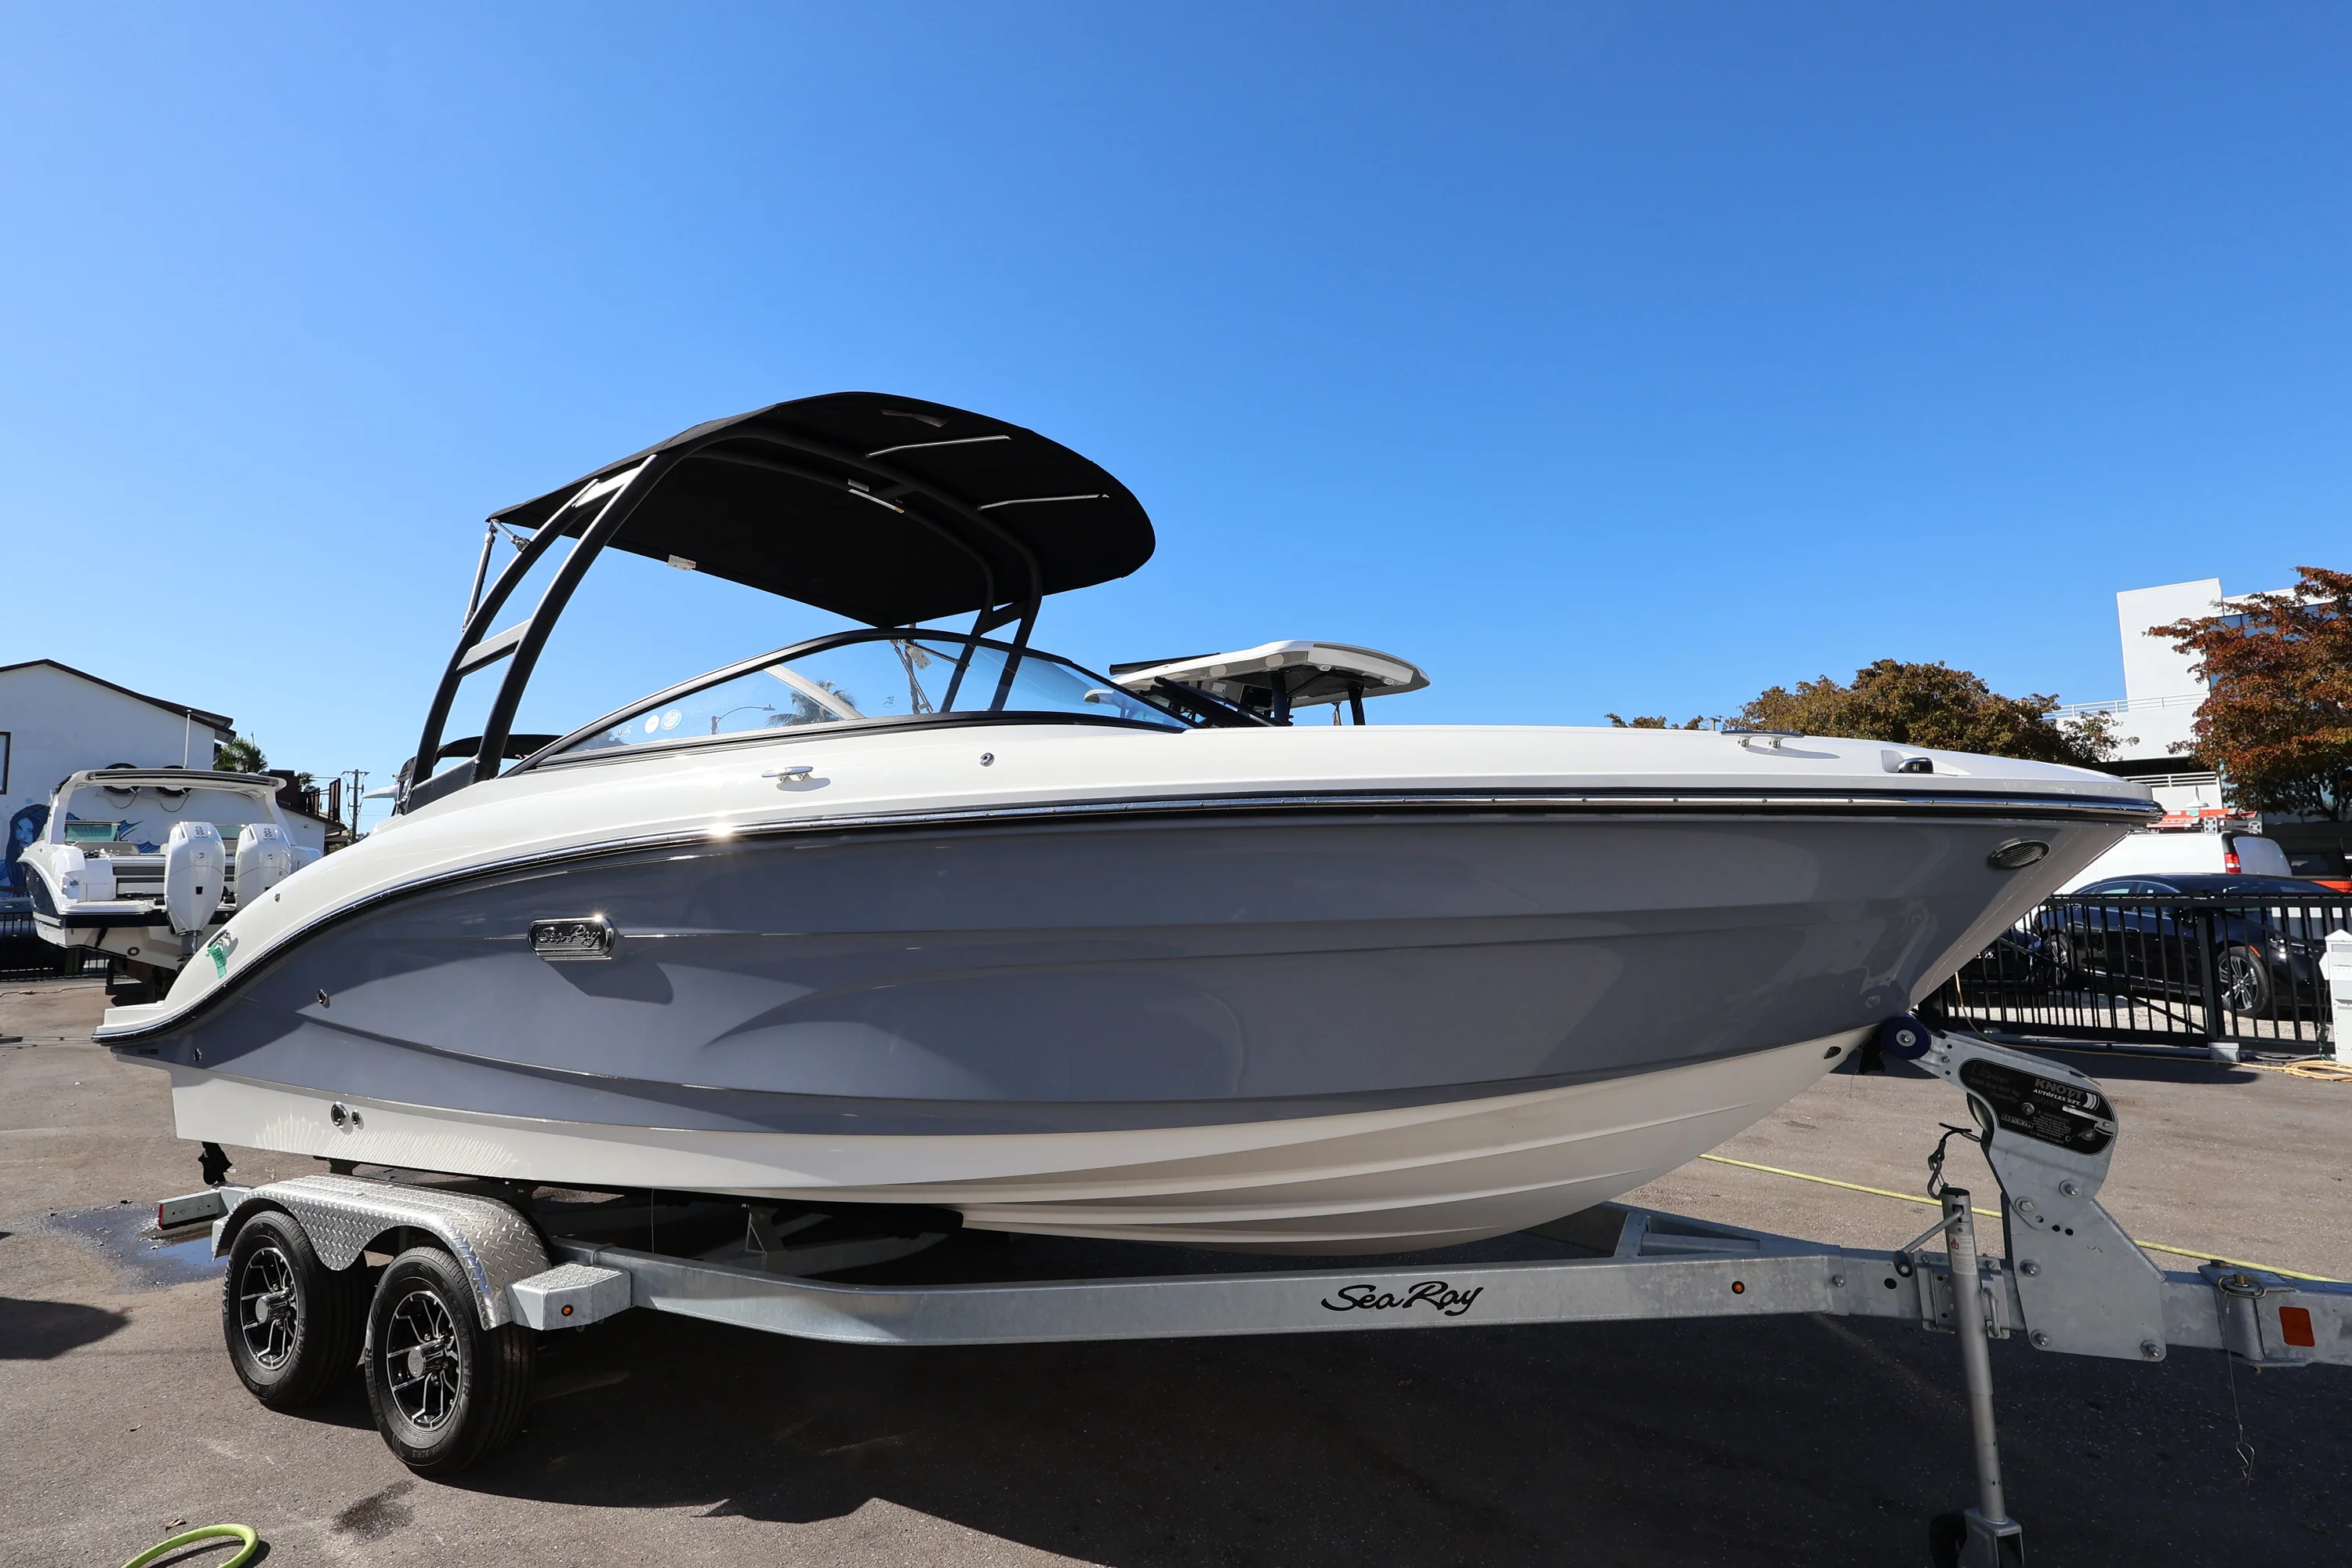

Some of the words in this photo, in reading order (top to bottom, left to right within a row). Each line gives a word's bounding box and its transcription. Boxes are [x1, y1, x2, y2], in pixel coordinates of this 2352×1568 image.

[536, 926, 569, 945] Sea
[570, 924, 601, 948] Ray
[2034, 1078, 2085, 1101] KNOTT
[1321, 1284, 1404, 1312] Sea
[1402, 1281, 1484, 1316] Ray
